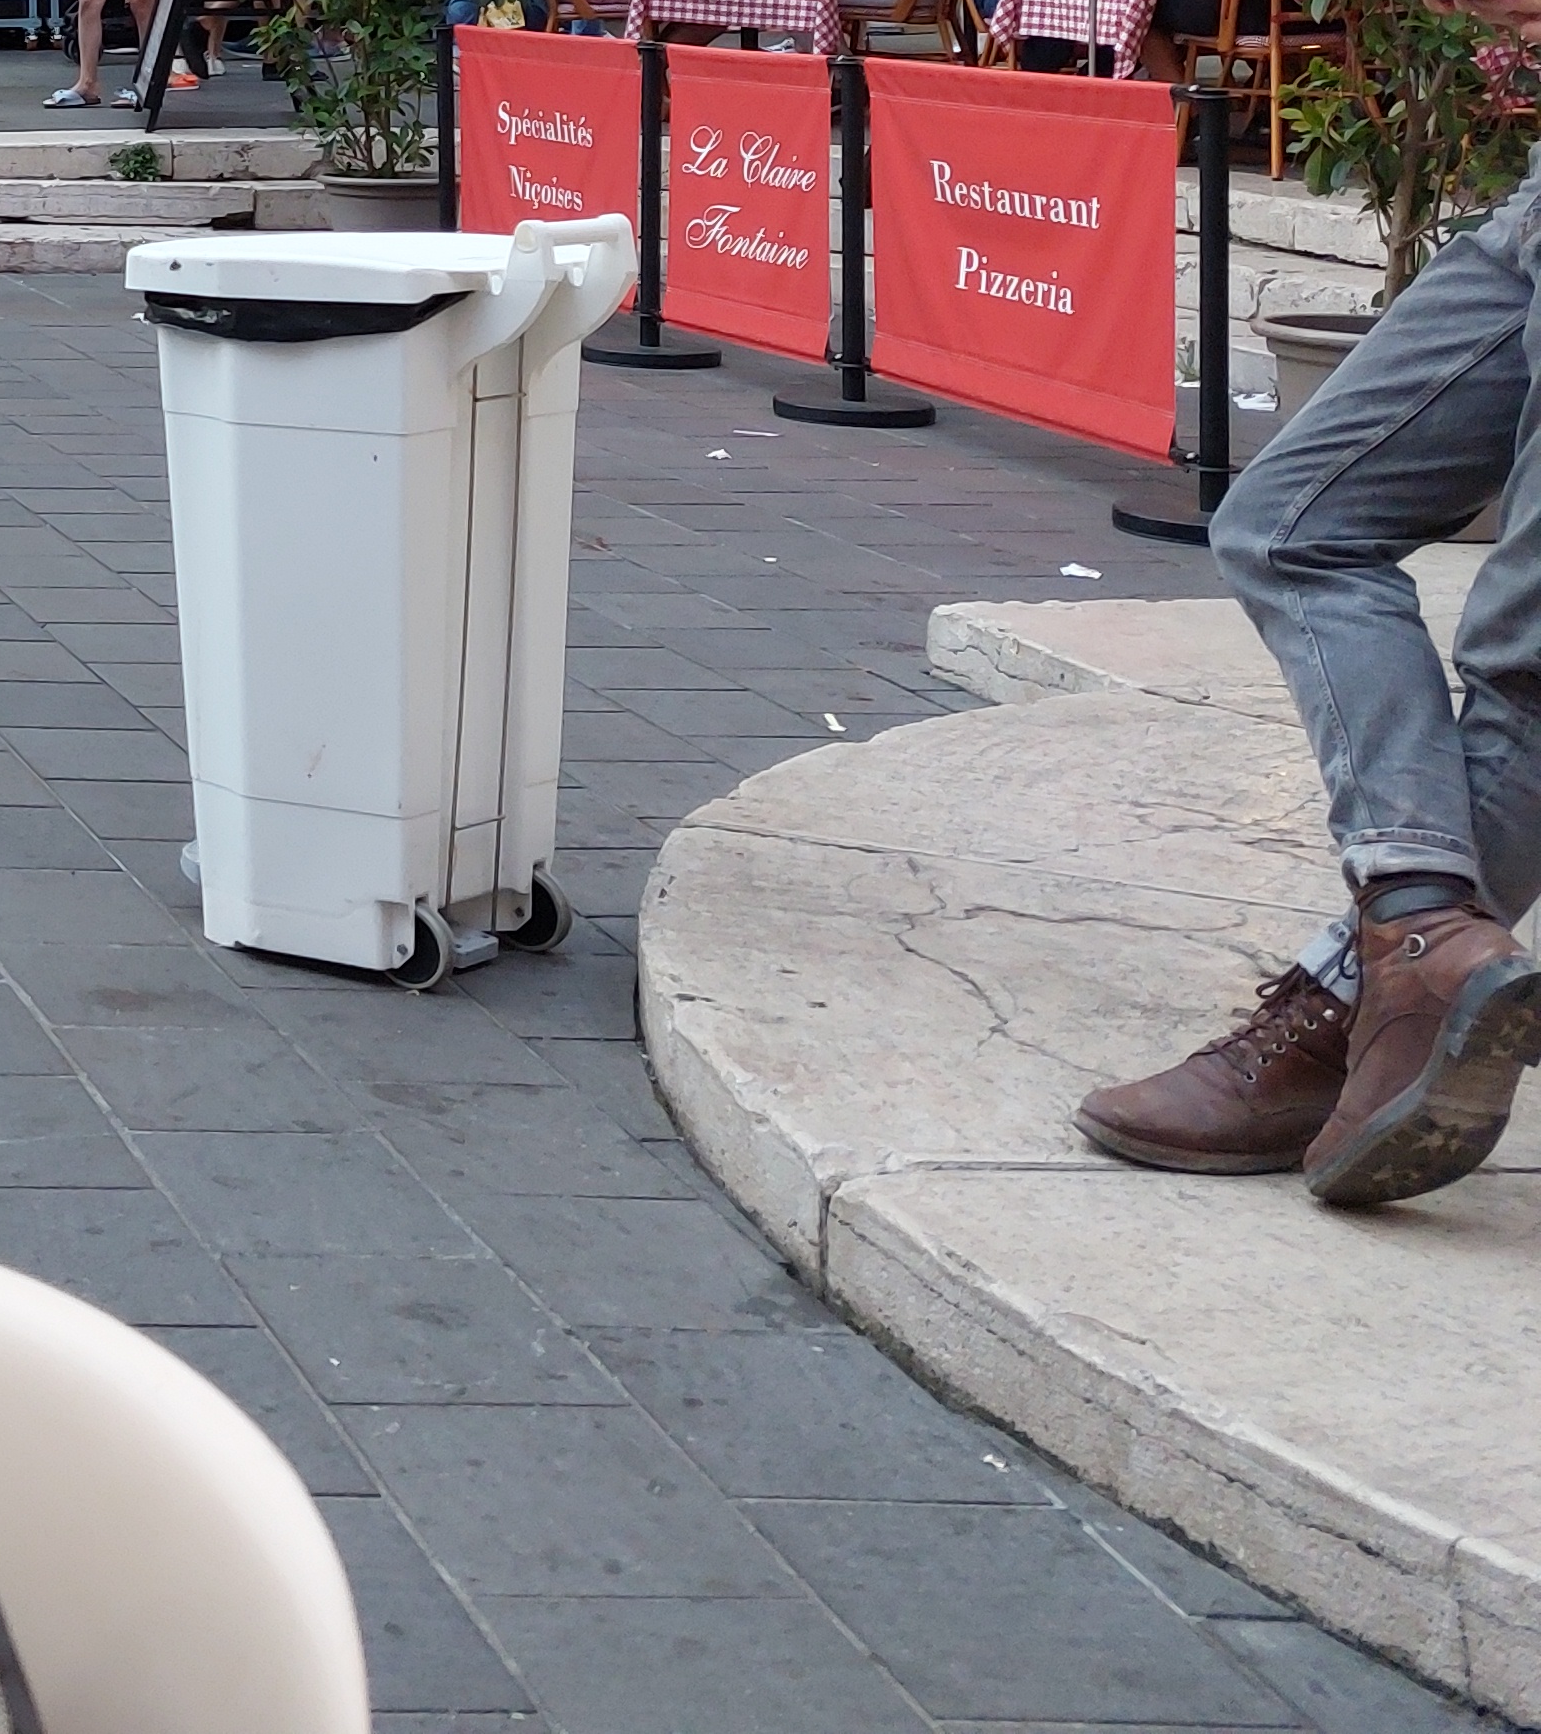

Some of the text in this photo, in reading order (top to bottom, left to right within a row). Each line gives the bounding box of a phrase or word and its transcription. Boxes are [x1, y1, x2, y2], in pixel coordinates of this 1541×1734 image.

[497, 100, 593, 148] Spécialités
[508, 164, 584, 212] Niçoises
[682, 125, 817, 192] La Claire
[929, 159, 1101, 229] Restaurant
[685, 204, 810, 270] Fontaine
[954, 246, 1076, 315] Pizzeria
